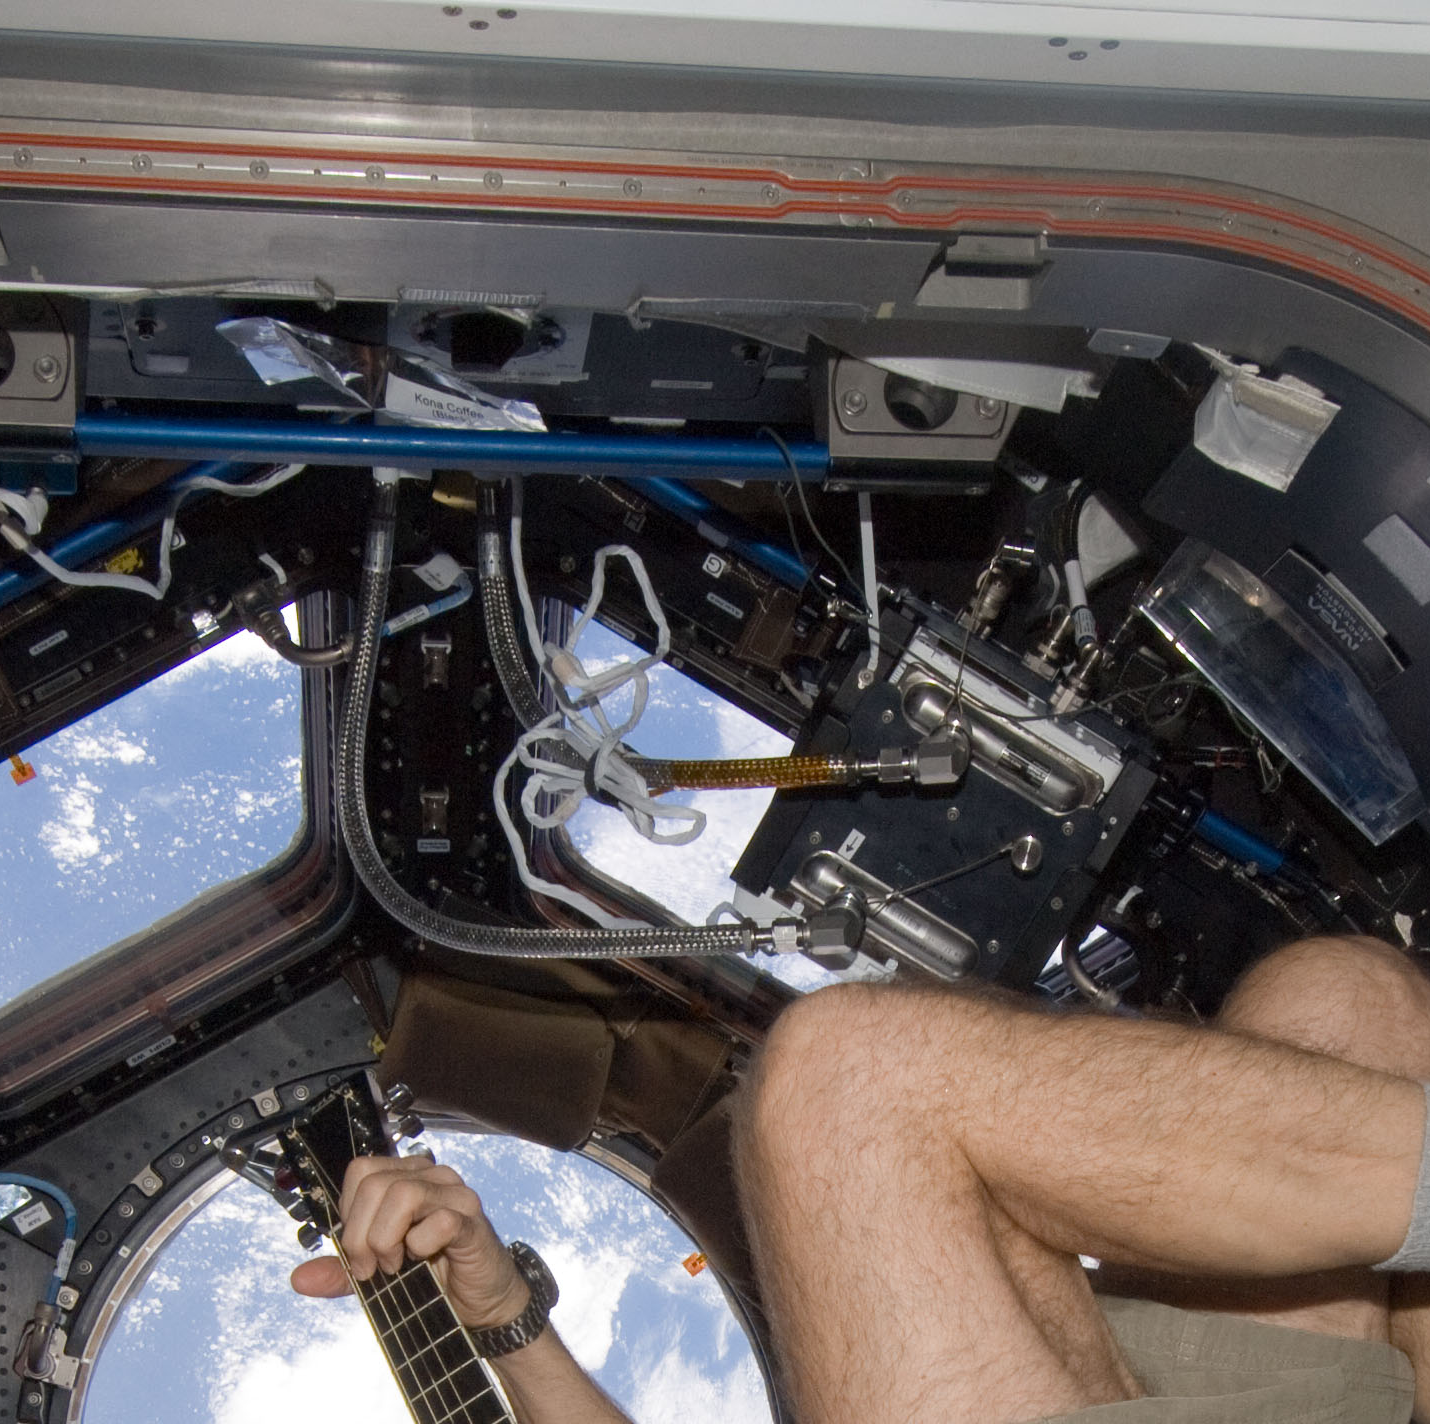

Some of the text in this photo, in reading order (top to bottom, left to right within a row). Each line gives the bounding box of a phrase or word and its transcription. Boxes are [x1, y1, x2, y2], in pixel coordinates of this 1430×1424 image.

[414, 392, 484, 418] Kona Coffee
[1308, 596, 1359, 651] NASA
[1316, 584, 1357, 624] HOUSTON
